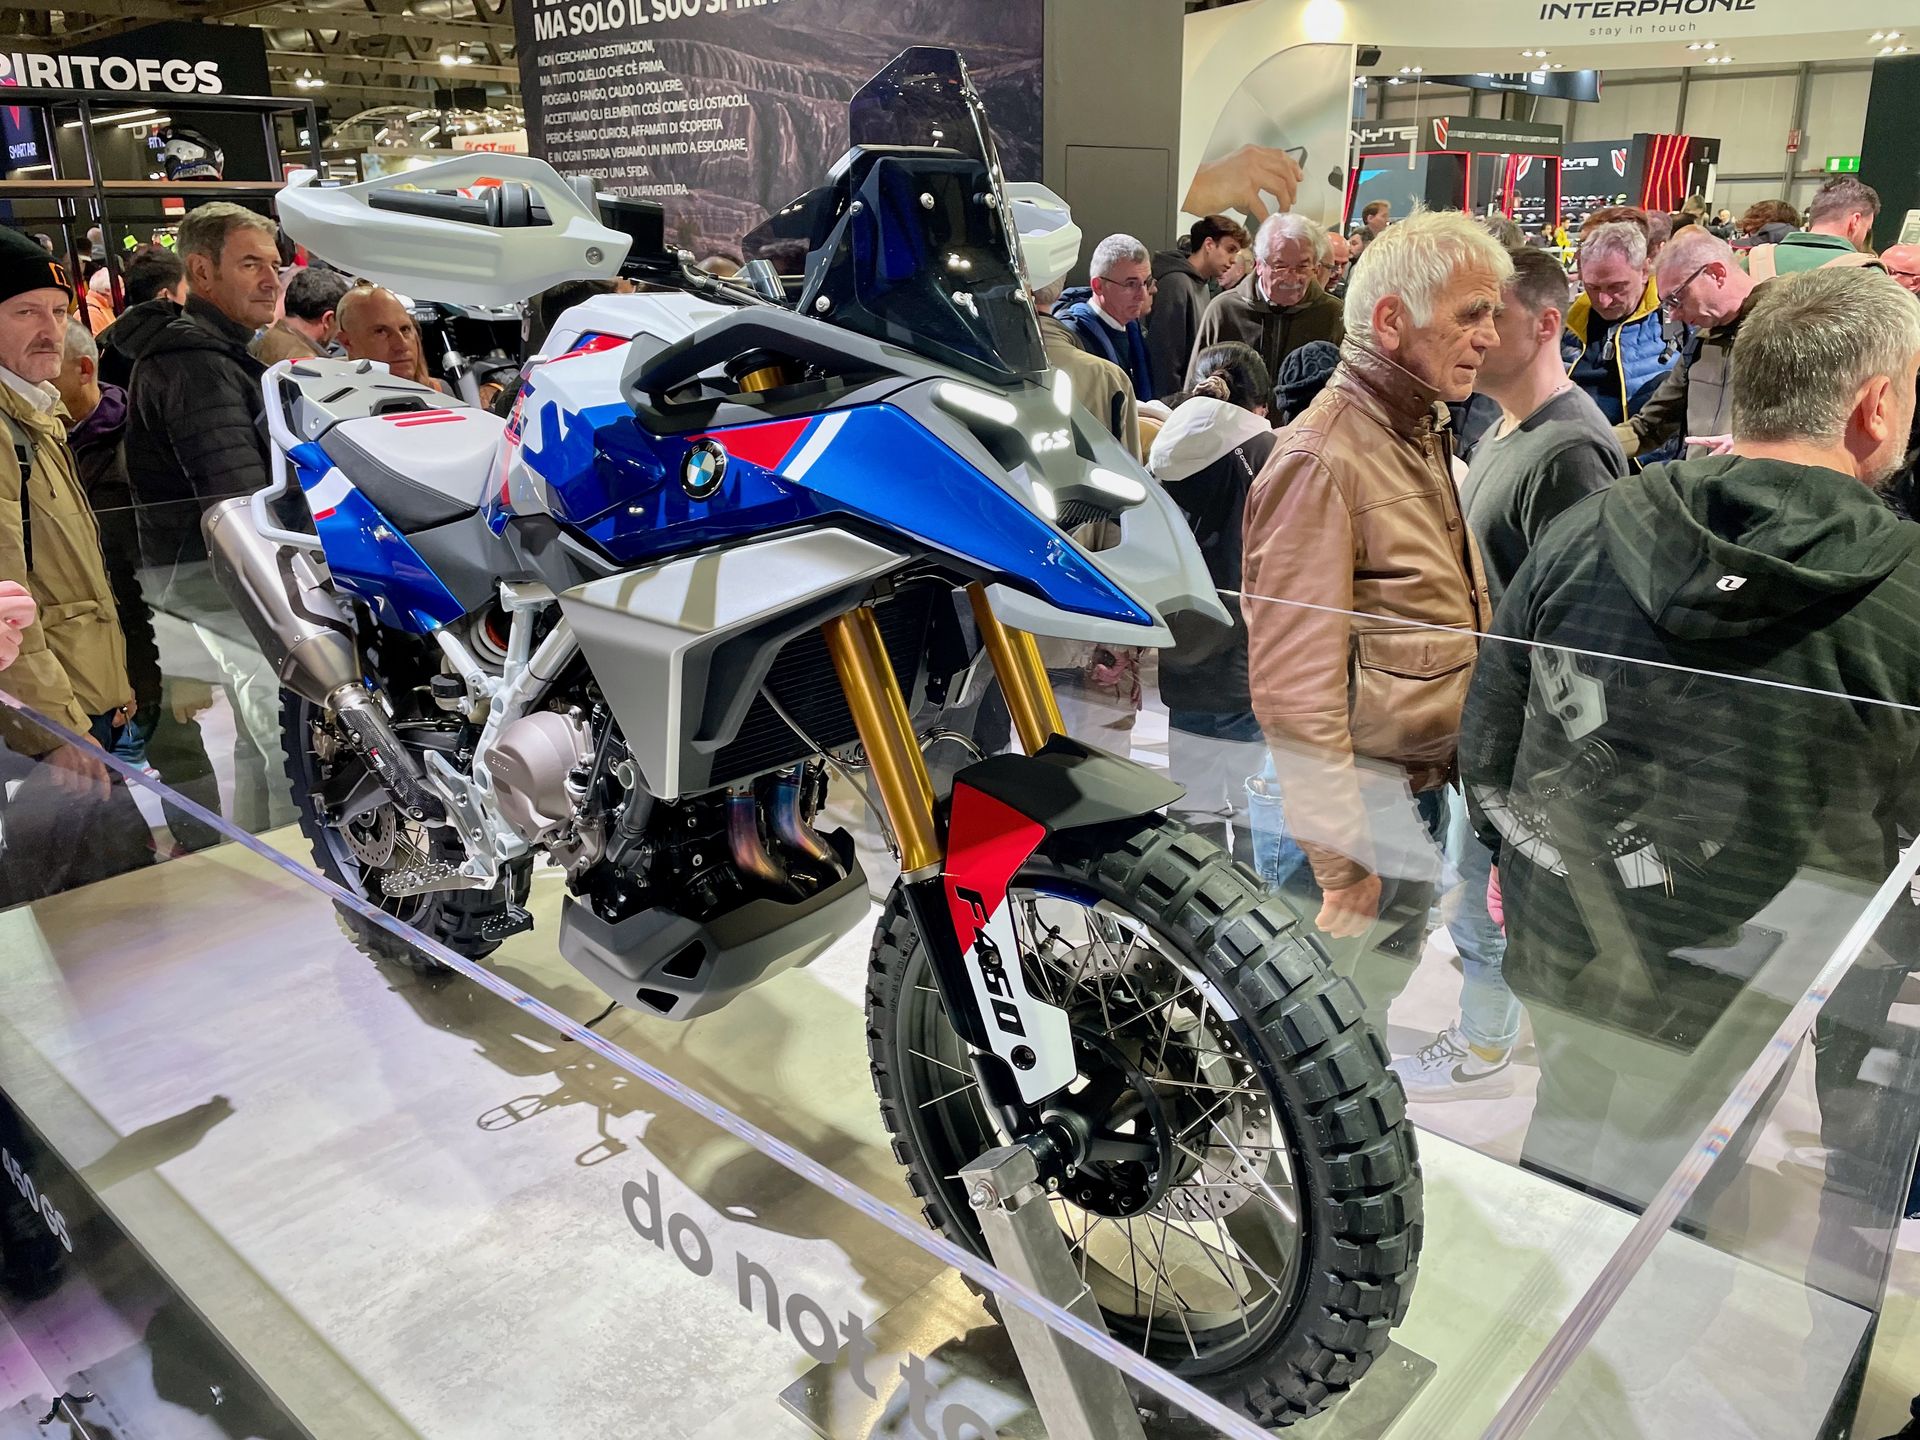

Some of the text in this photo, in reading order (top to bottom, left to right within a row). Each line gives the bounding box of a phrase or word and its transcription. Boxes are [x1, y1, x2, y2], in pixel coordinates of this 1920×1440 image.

[533, 9, 568, 41] MA
[568, 0, 626, 35] SOLO
[629, 0, 650, 26] IL
[652, 0, 701, 22] SUO
[1540, 0, 1757, 20] INTERPHONE
[1589, 21, 1697, 37] stay in touch
[538, 39, 656, 67] NON CERCHIAMO DESTINAZIONI,
[539, 75, 552, 87] MA
[552, 71, 576, 85] TUTTO
[577, 67, 606, 82] QUELLO
[607, 64, 624, 79] CHE
[541, 92, 572, 106] PIOGGIA
[572, 91, 579, 103] O
[580, 87, 608, 101] FANGO,
[608, 84, 635, 99] CALDO
[636, 83, 644, 96] O
[543, 109, 590, 126] ACCETTIAMO
[603, 104, 641, 119] ELEMENTI
[662, 99, 688, 113] COME
[688, 97, 704, 111] GLI
[574, 128, 598, 142] SIAMO
[598, 125, 630, 140] CURIOSI,
[630, 122, 668, 137] AFFAMATI
[669, 121, 679, 134] DI
[679, 118, 724, 133] SCOPERTA
[547, 138, 748, 163] E IN OGNI STRADA VEDIAMO UN INVITO A ESPLORARE,
[609, 166, 626, 178] UNA
[626, 165, 650, 177] SFIDA
[2, 1147, 73, 1253] 450 GS
[621, 1169, 714, 1277] do
[736, 1250, 878, 1400] not
